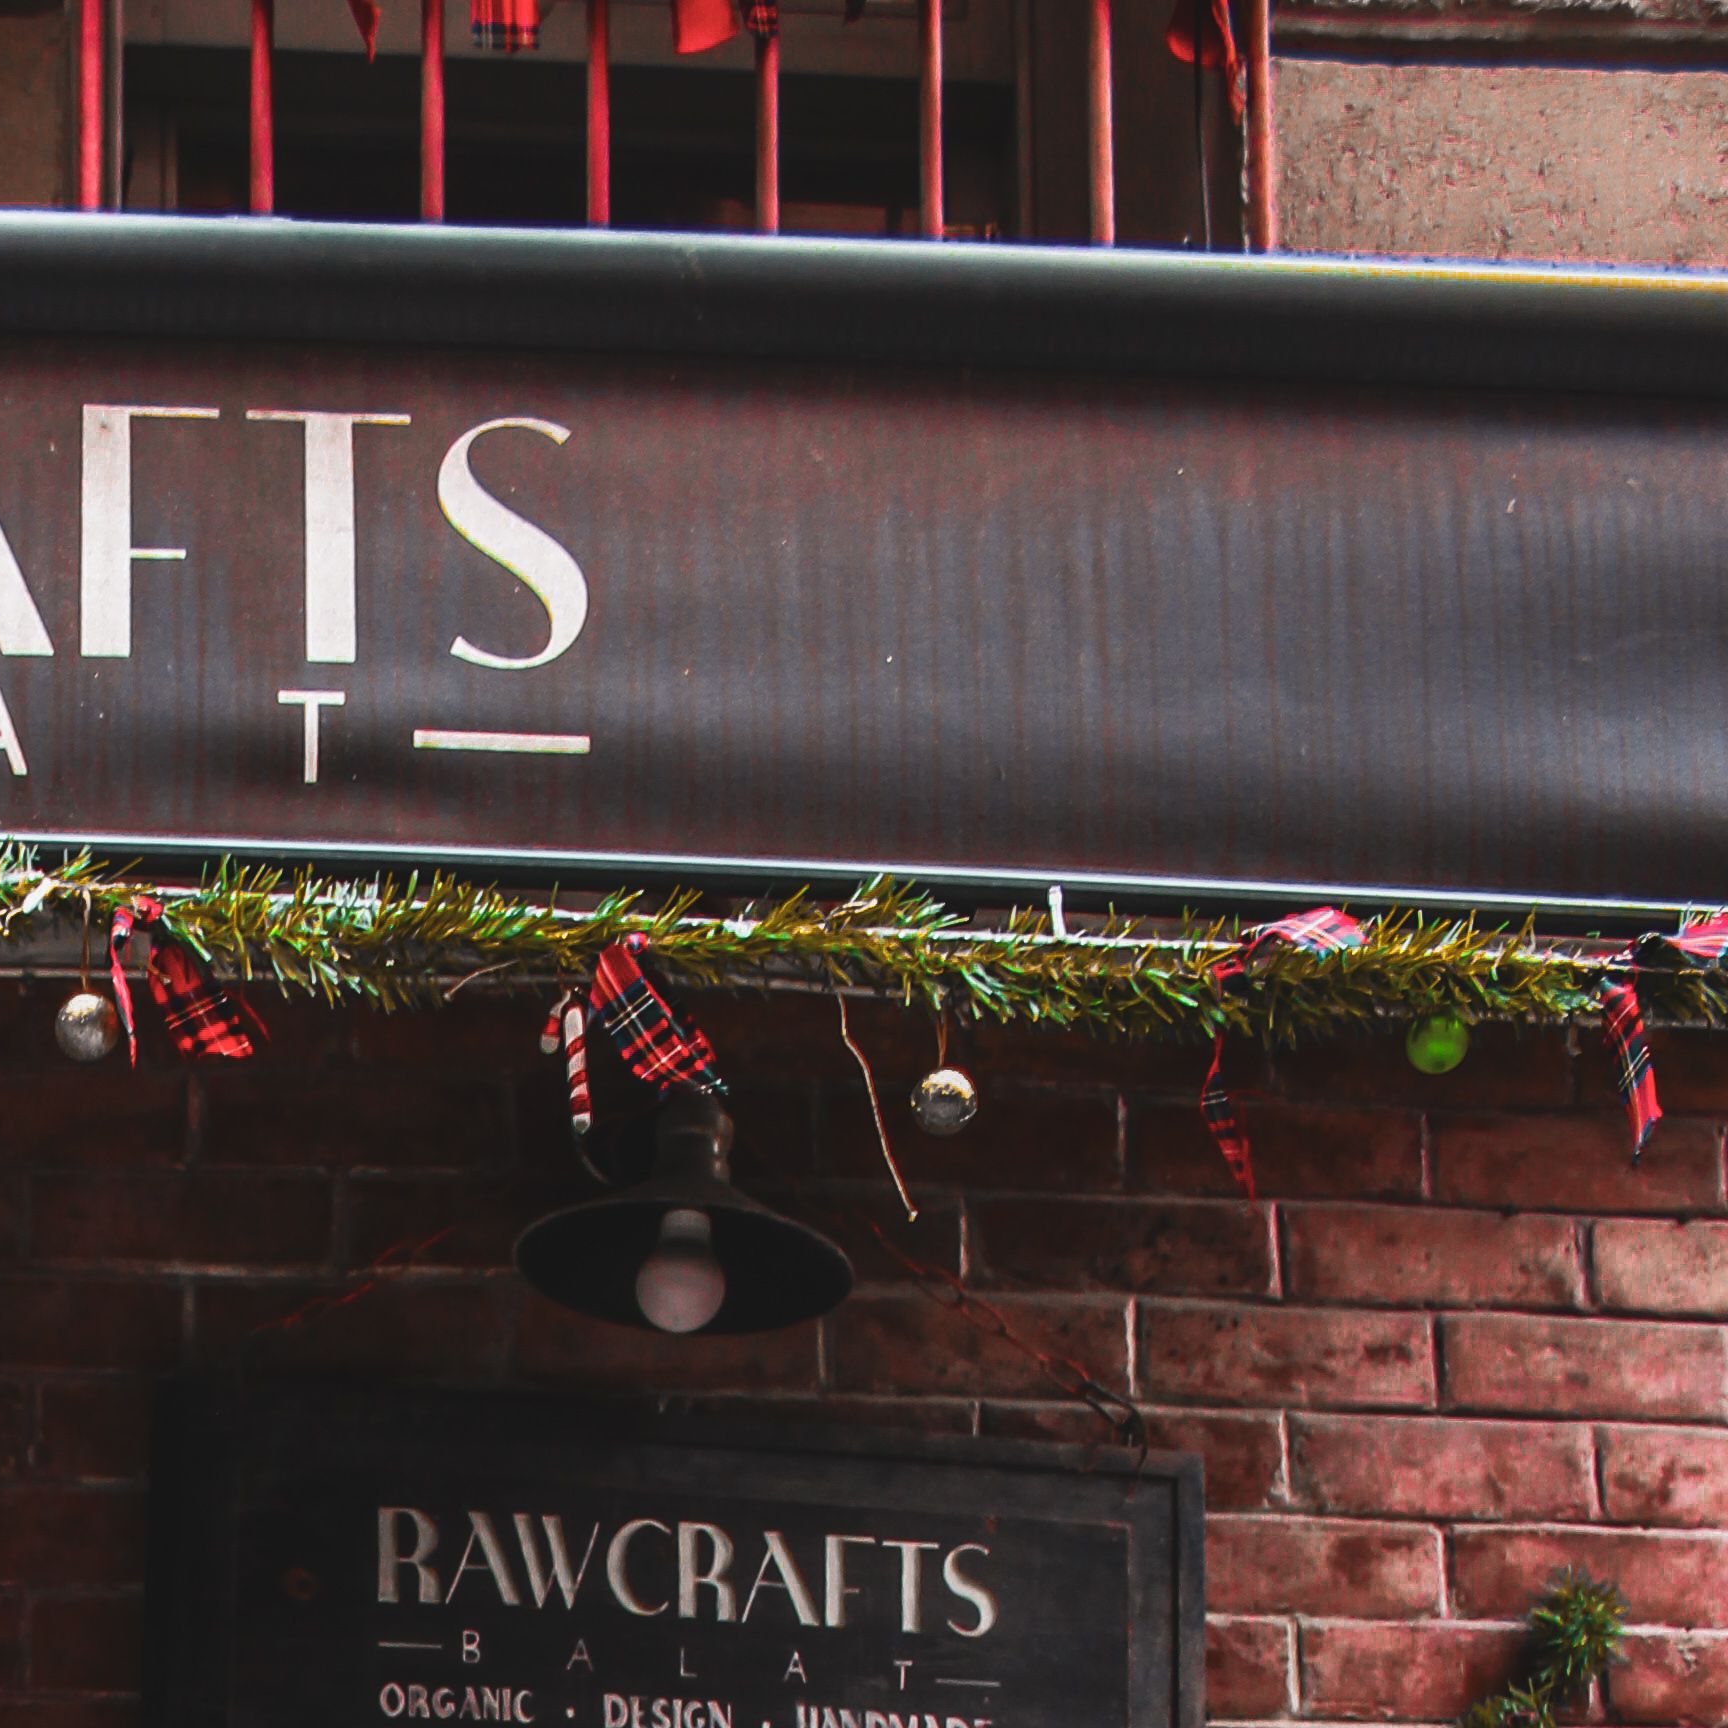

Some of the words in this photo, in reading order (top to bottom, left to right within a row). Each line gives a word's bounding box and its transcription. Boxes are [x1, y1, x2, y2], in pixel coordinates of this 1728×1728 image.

[376, 1505, 1000, 1640] RAWCRAFTS
[460, 1628, 913, 1692] BALAT
[378, 1682, 537, 1725] ORGANIC
